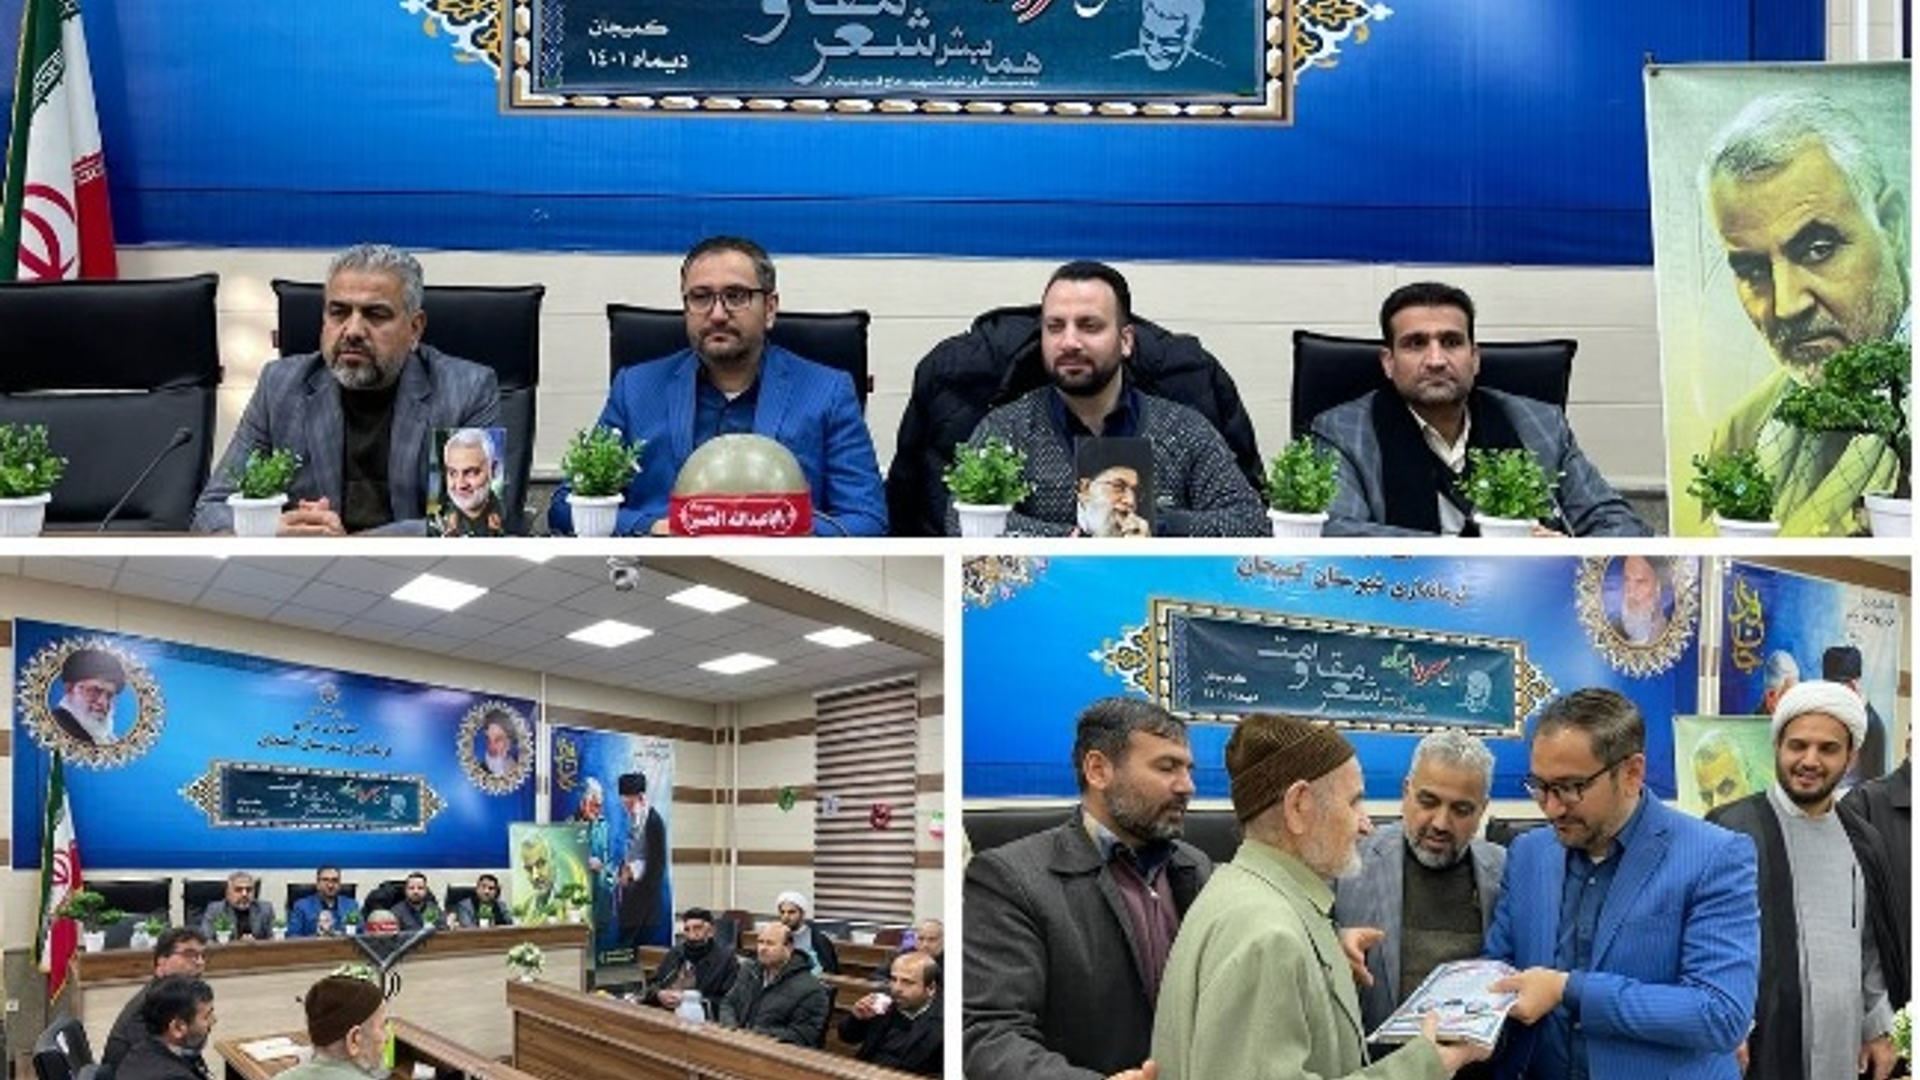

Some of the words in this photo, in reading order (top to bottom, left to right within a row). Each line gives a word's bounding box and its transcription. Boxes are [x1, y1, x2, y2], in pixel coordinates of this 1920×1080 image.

[588, 18, 669, 39] کمیجان
[632, 49, 689, 74] دیماه
[790, 7, 938, 86] شعر
[1236, 556, 1305, 587] کمیجان
[1313, 566, 1385, 595] شهرستان
[1257, 634, 1366, 690] مقاومت
[1320, 675, 1381, 716] شعر
